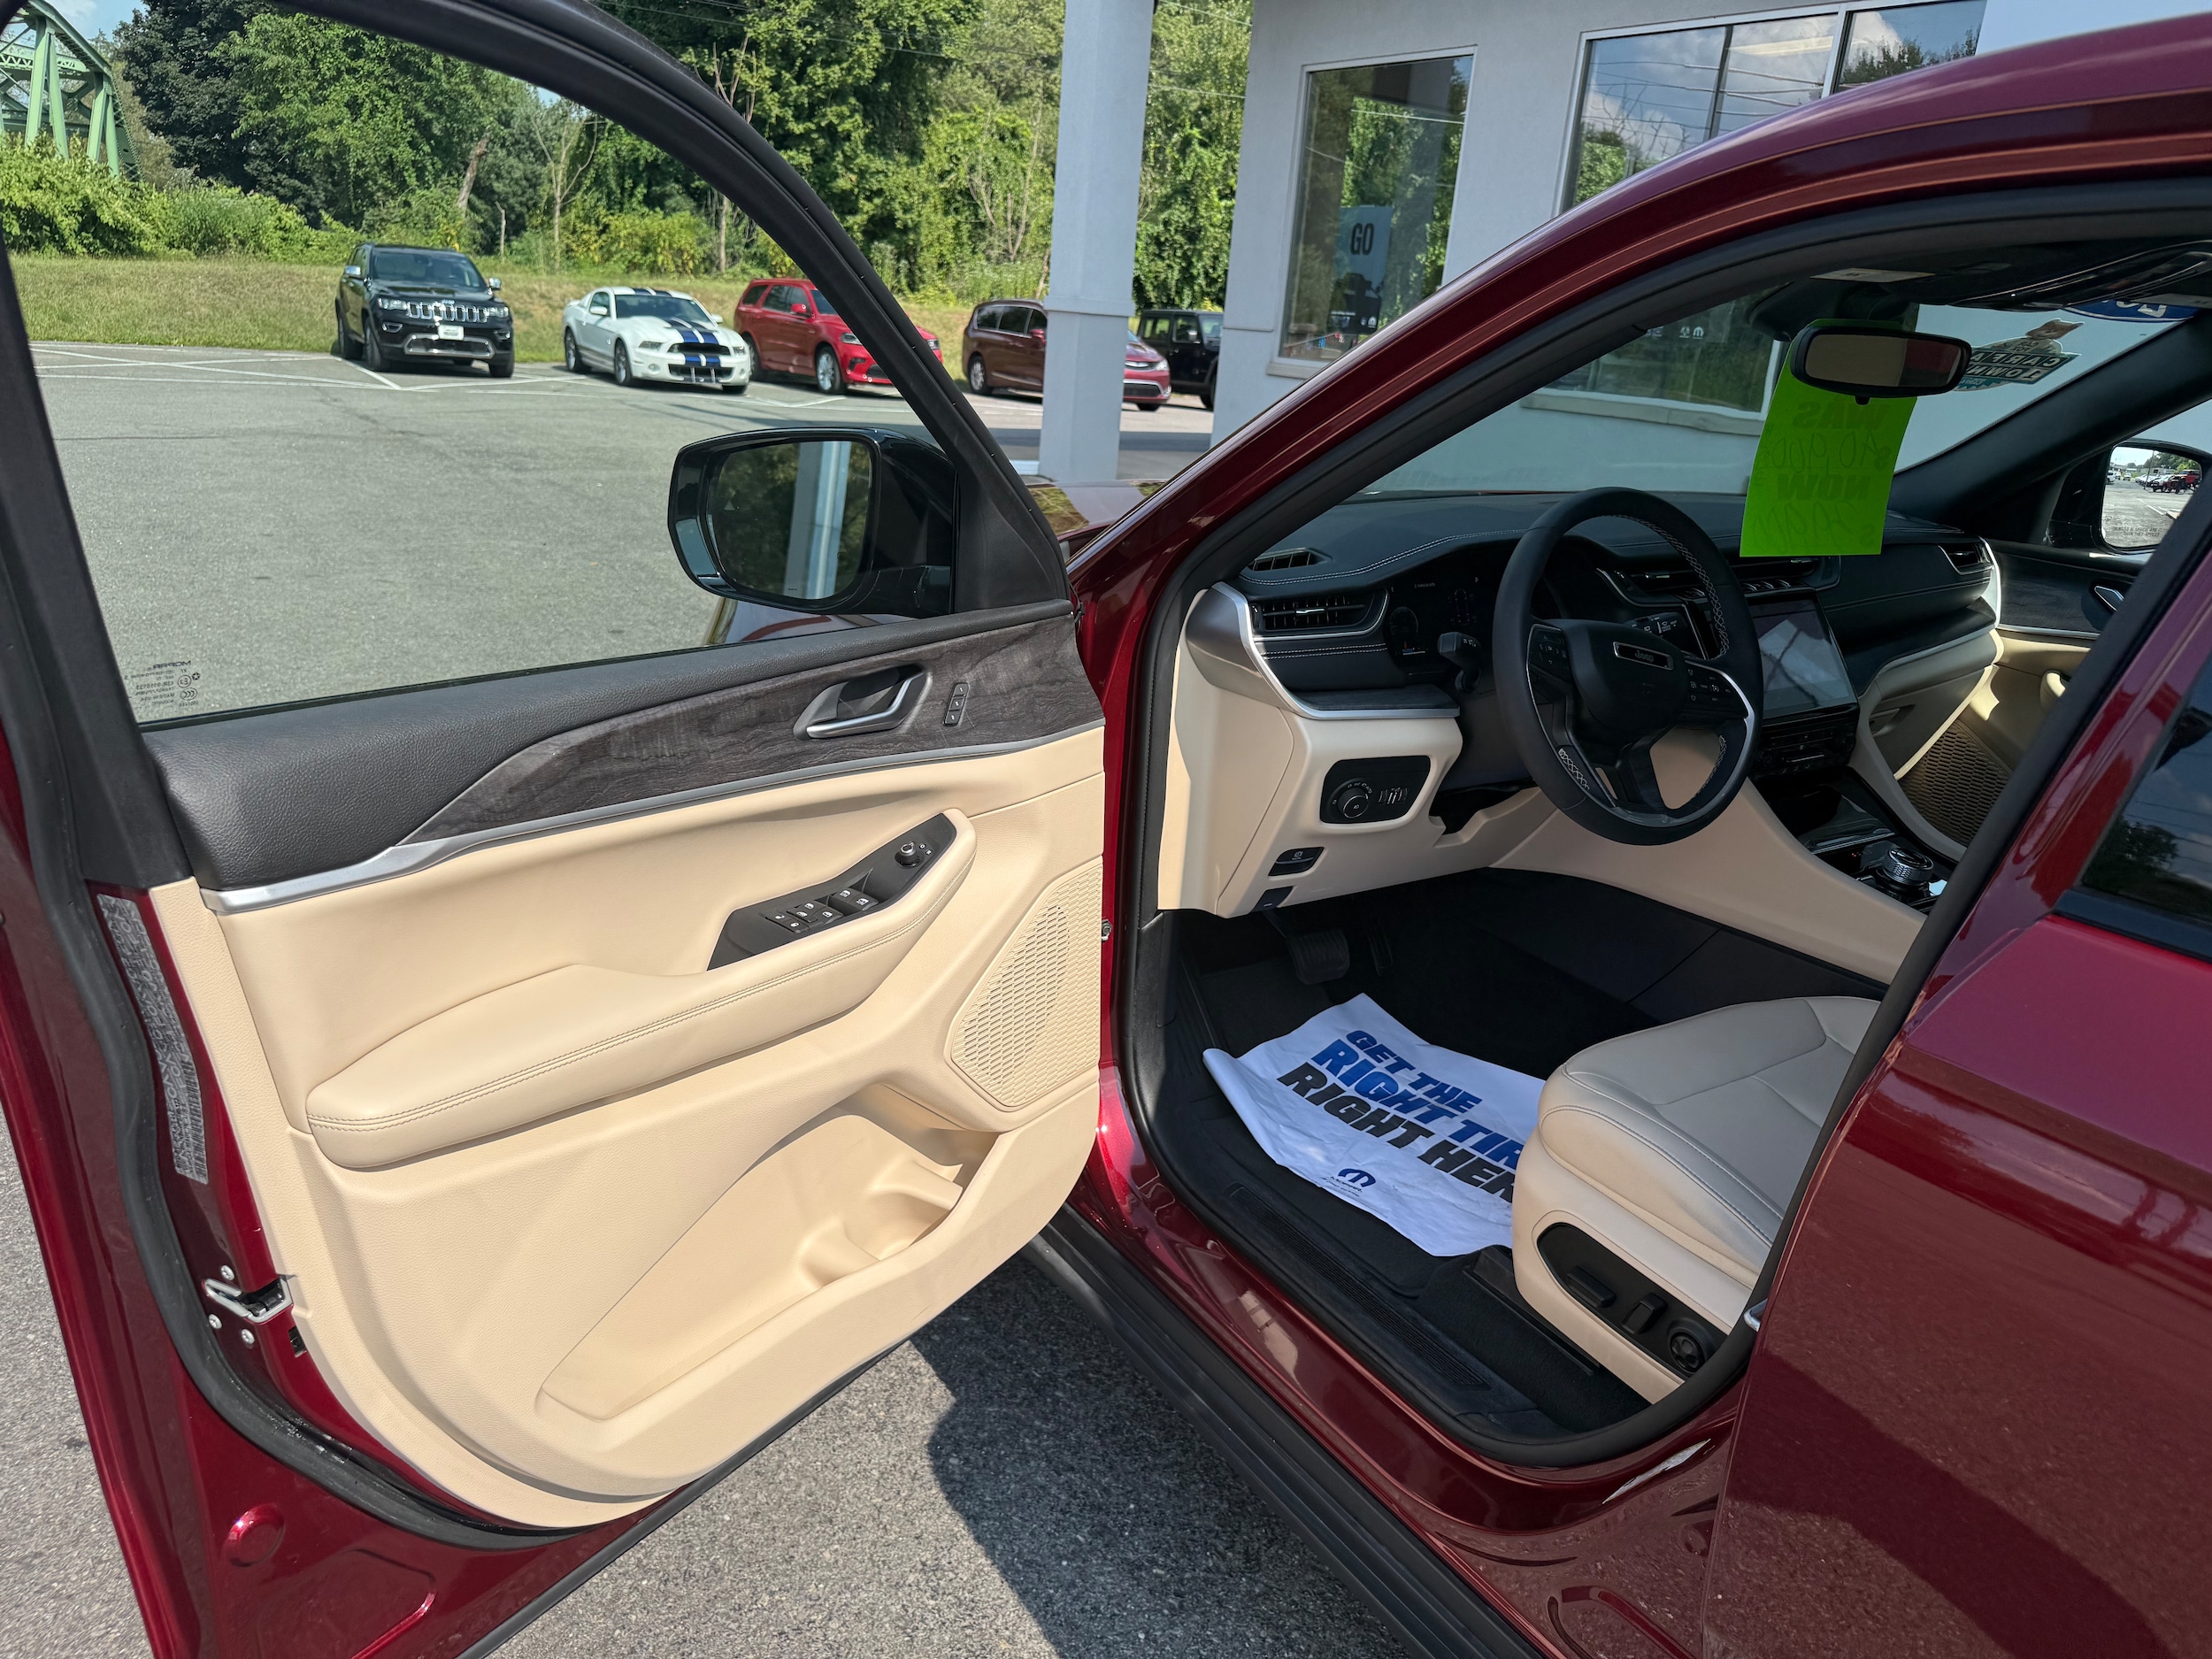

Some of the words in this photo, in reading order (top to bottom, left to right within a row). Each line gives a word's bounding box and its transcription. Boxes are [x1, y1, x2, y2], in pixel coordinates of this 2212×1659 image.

[1350, 223, 1374, 256] GO
[1310, 1039, 1458, 1124] RIGHT
[1447, 1119, 1525, 1170] TIR
[1346, 1030, 1416, 1074] GET
[1408, 1071, 1482, 1114] THE
[1277, 1062, 1435, 1148] RIGHT
[1417, 1140, 1515, 1203] HER
